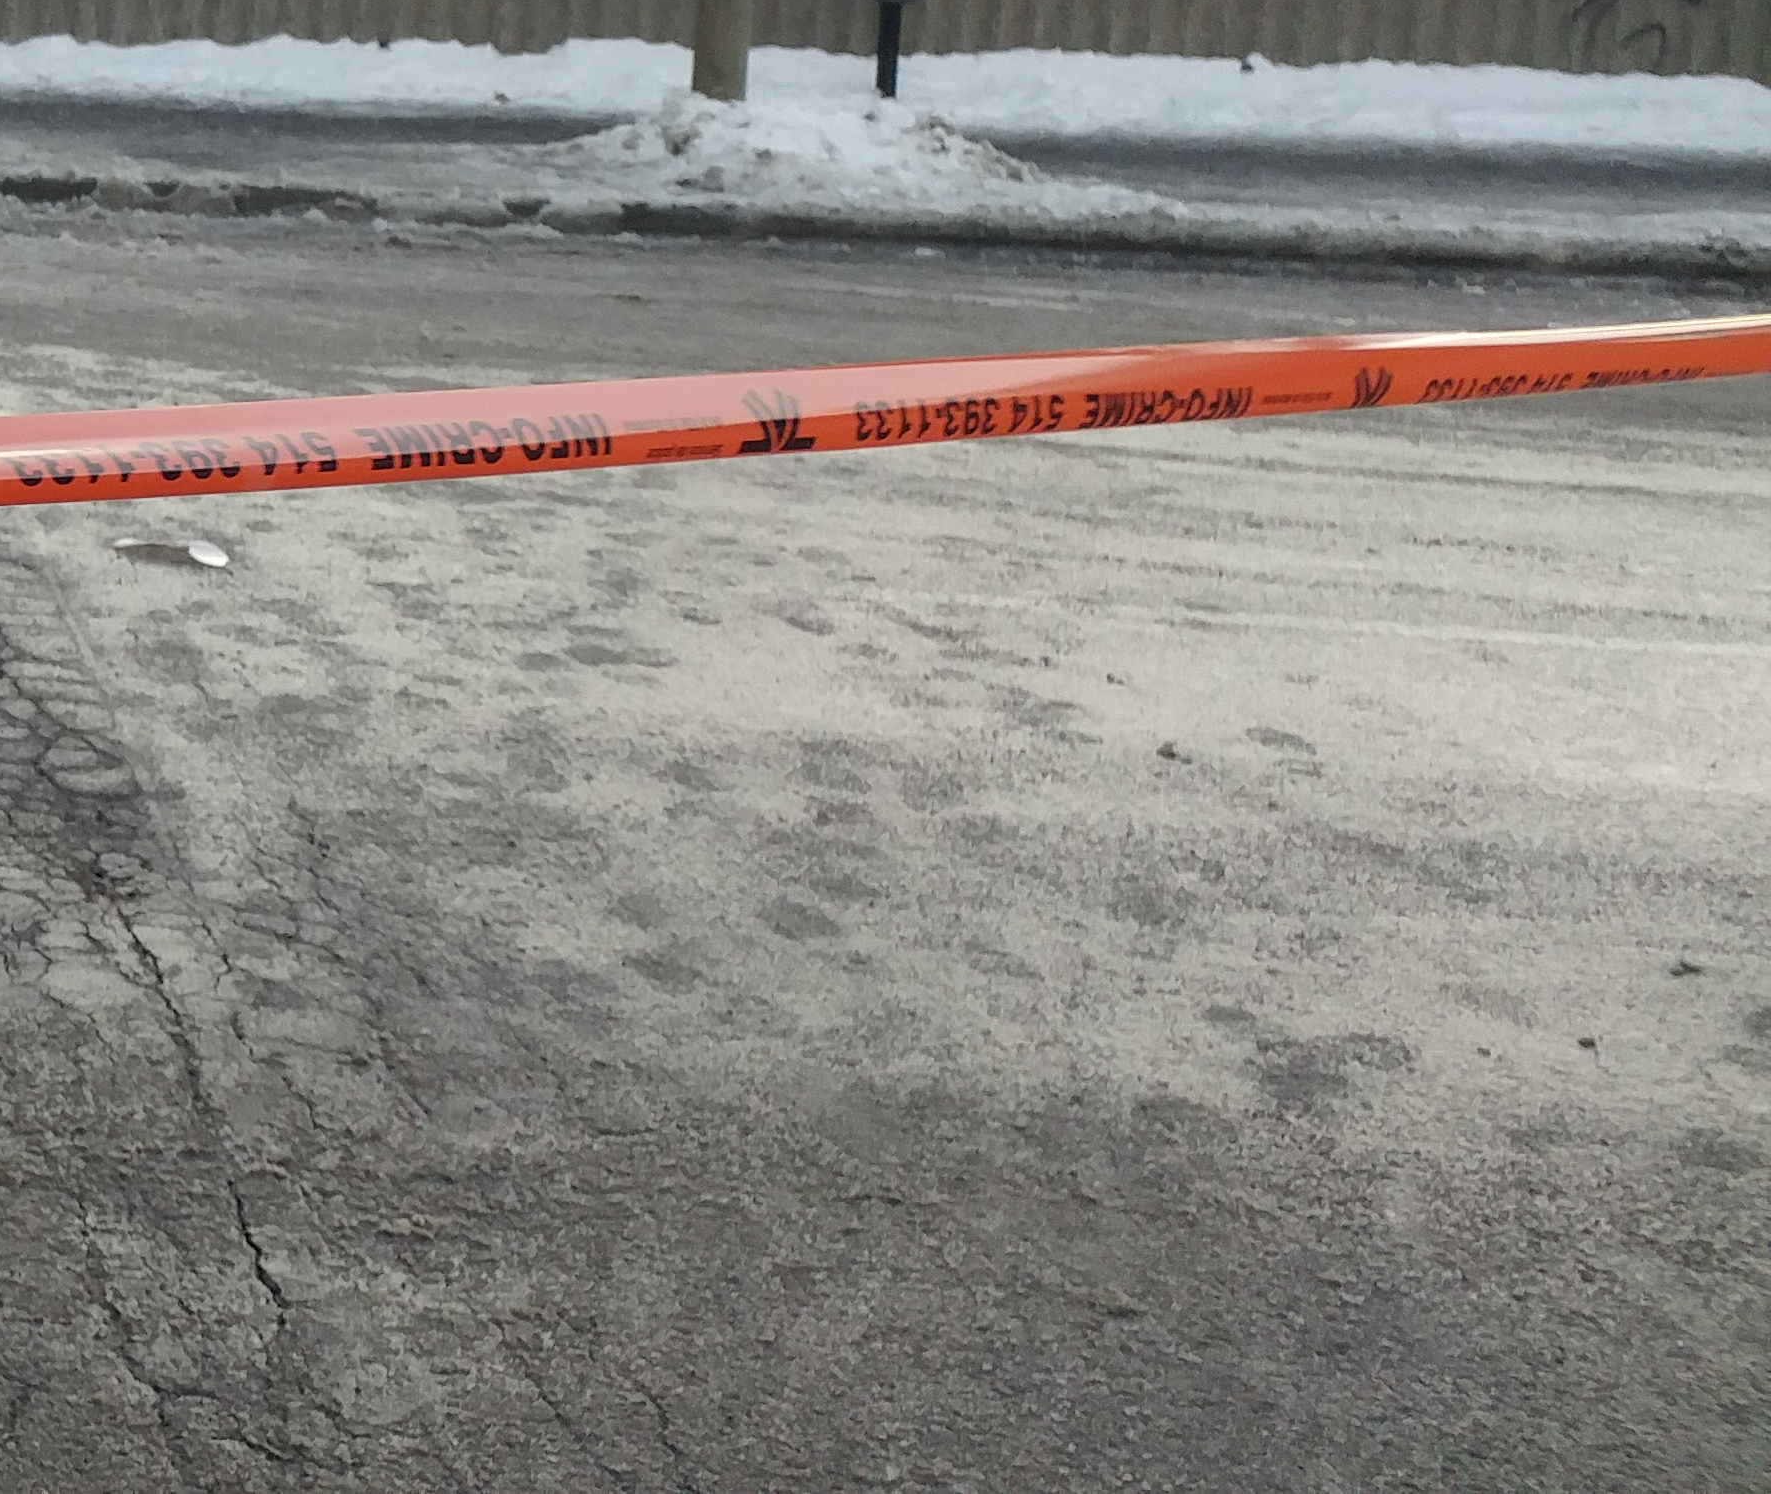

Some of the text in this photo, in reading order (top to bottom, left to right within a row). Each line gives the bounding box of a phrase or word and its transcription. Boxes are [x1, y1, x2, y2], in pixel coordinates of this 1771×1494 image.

[854, 385, 1254, 442] INFO-CRIME 514 393-1133
[2, 412, 613, 487] INFO-CRIME 514 393-1133
